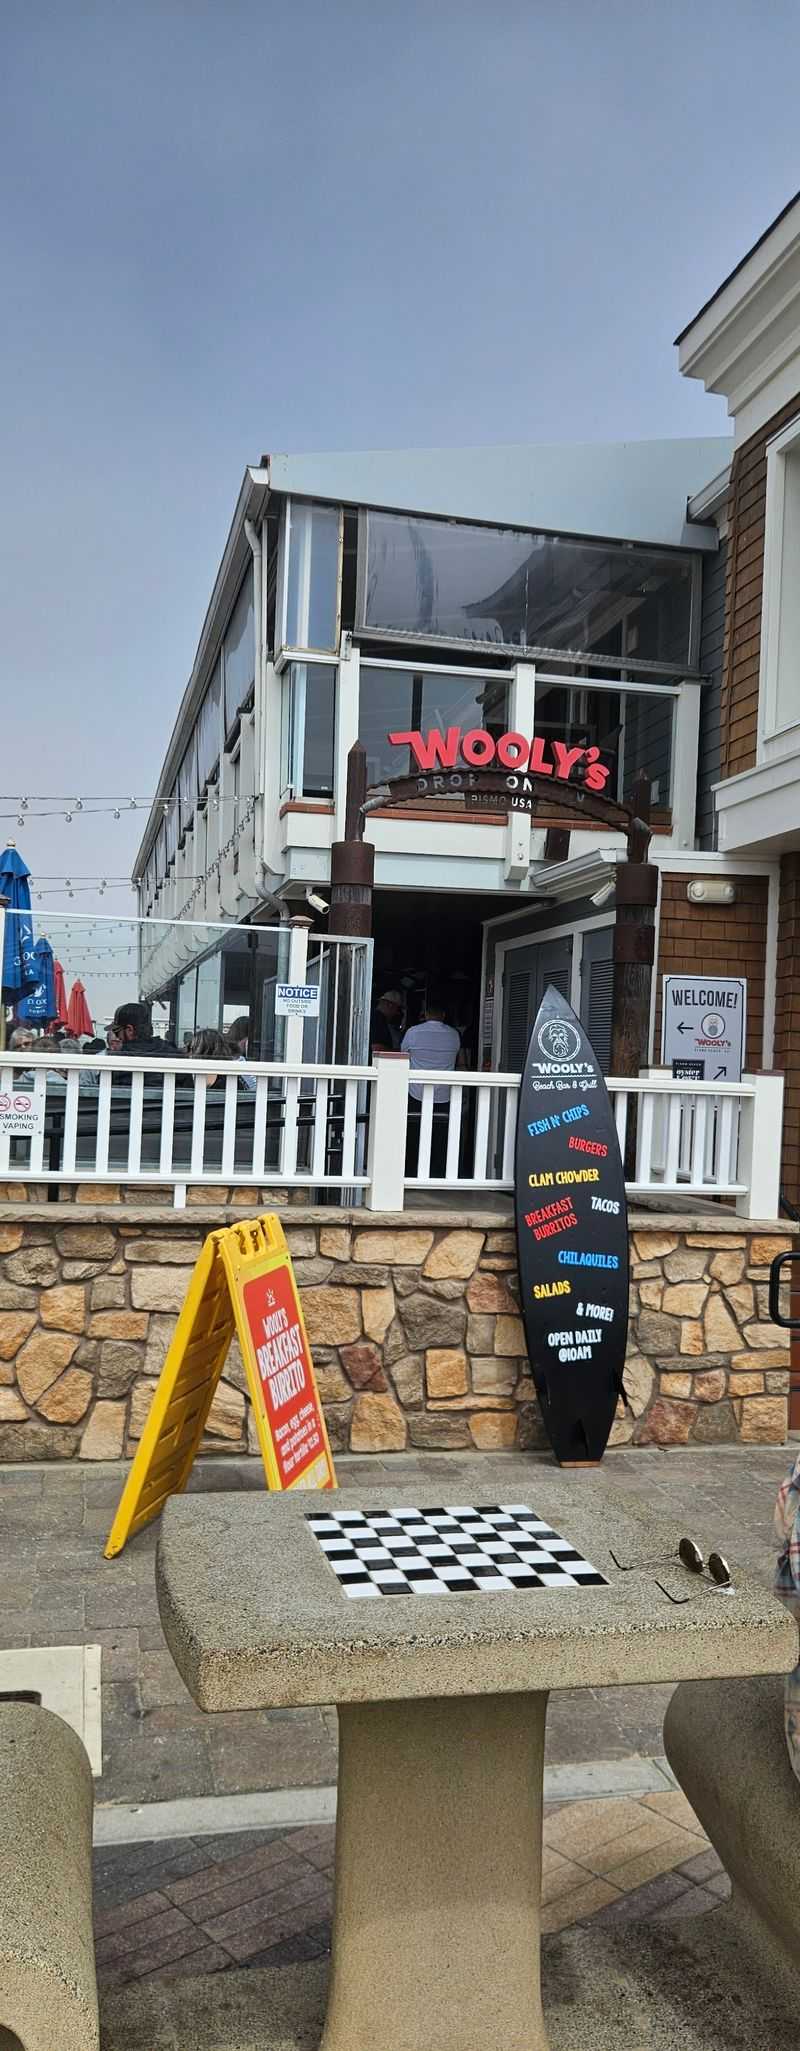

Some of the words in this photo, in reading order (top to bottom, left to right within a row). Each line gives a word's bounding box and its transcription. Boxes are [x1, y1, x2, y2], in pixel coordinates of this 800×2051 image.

[511, 796, 532, 809] USA
[278, 987, 317, 998] NOTICE
[672, 989, 738, 1009] WELCOME!
[532, 1080, 555, 1091] Beach
[555, 1080, 571, 1091] Bar
[579, 1079, 598, 1092] Grill
[0, 1113, 39, 1121] SMOKING
[3, 1122, 34, 1130] VAPING
[527, 1118, 550, 1137] FISH
[562, 1103, 590, 1123] CHIPS
[568, 1136, 608, 1157] BURGERS
[528, 1171, 554, 1188] CLAM
[555, 1168, 600, 1185] CHOWDER
[524, 1196, 574, 1227] BREAKFAST
[591, 1196, 620, 1214] TACOS
[533, 1213, 578, 1241] BURRITOS
[558, 1250, 619, 1269] CHILAQUILES
[533, 1280, 571, 1299] SALADS
[576, 1302, 584, 1316] &
[585, 1303, 614, 1322] MORE!
[548, 1331, 574, 1347] OPEN
[575, 1329, 602, 1344] DAILY
[256, 1323, 304, 1381] BREAKFAST
[558, 1345, 592, 1362] @10AM
[268, 1358, 306, 1411] BURRITO
